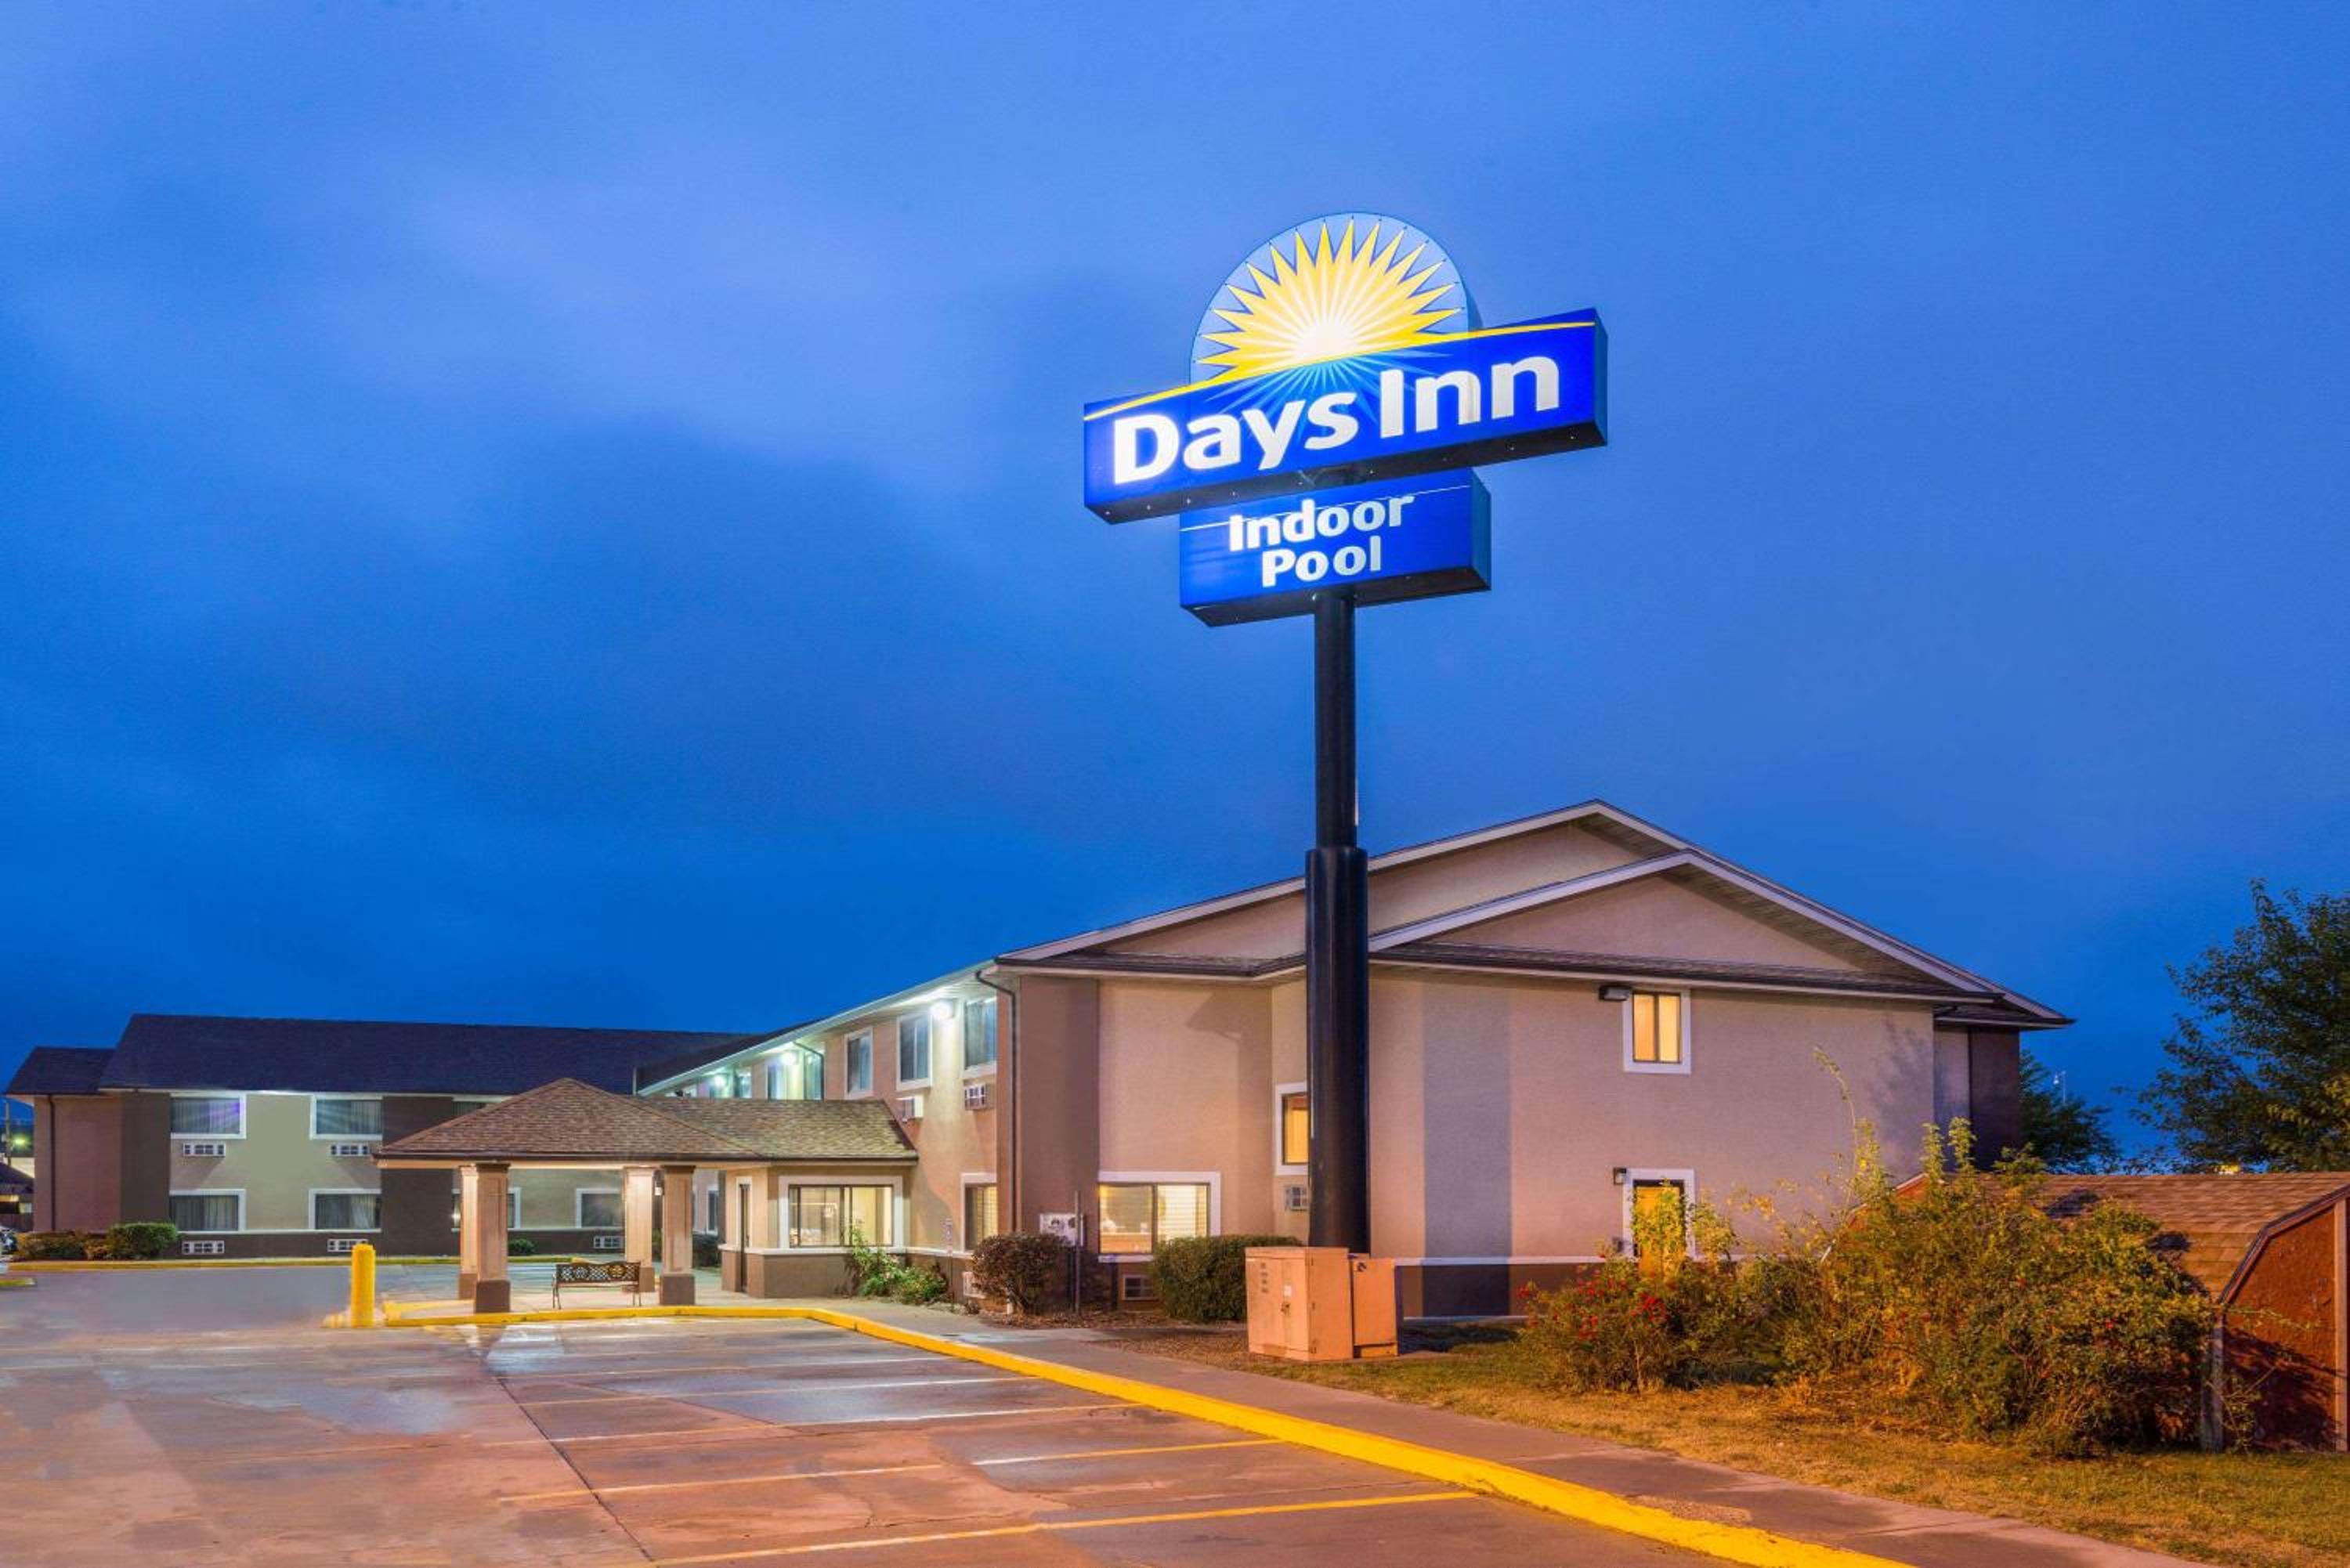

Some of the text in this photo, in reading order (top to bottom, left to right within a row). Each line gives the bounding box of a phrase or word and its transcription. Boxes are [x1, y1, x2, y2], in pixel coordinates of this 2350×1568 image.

[1112, 356, 1560, 485] Days Inn
[1229, 495, 1414, 551] Indoor
[1262, 536, 1381, 587] Pool
